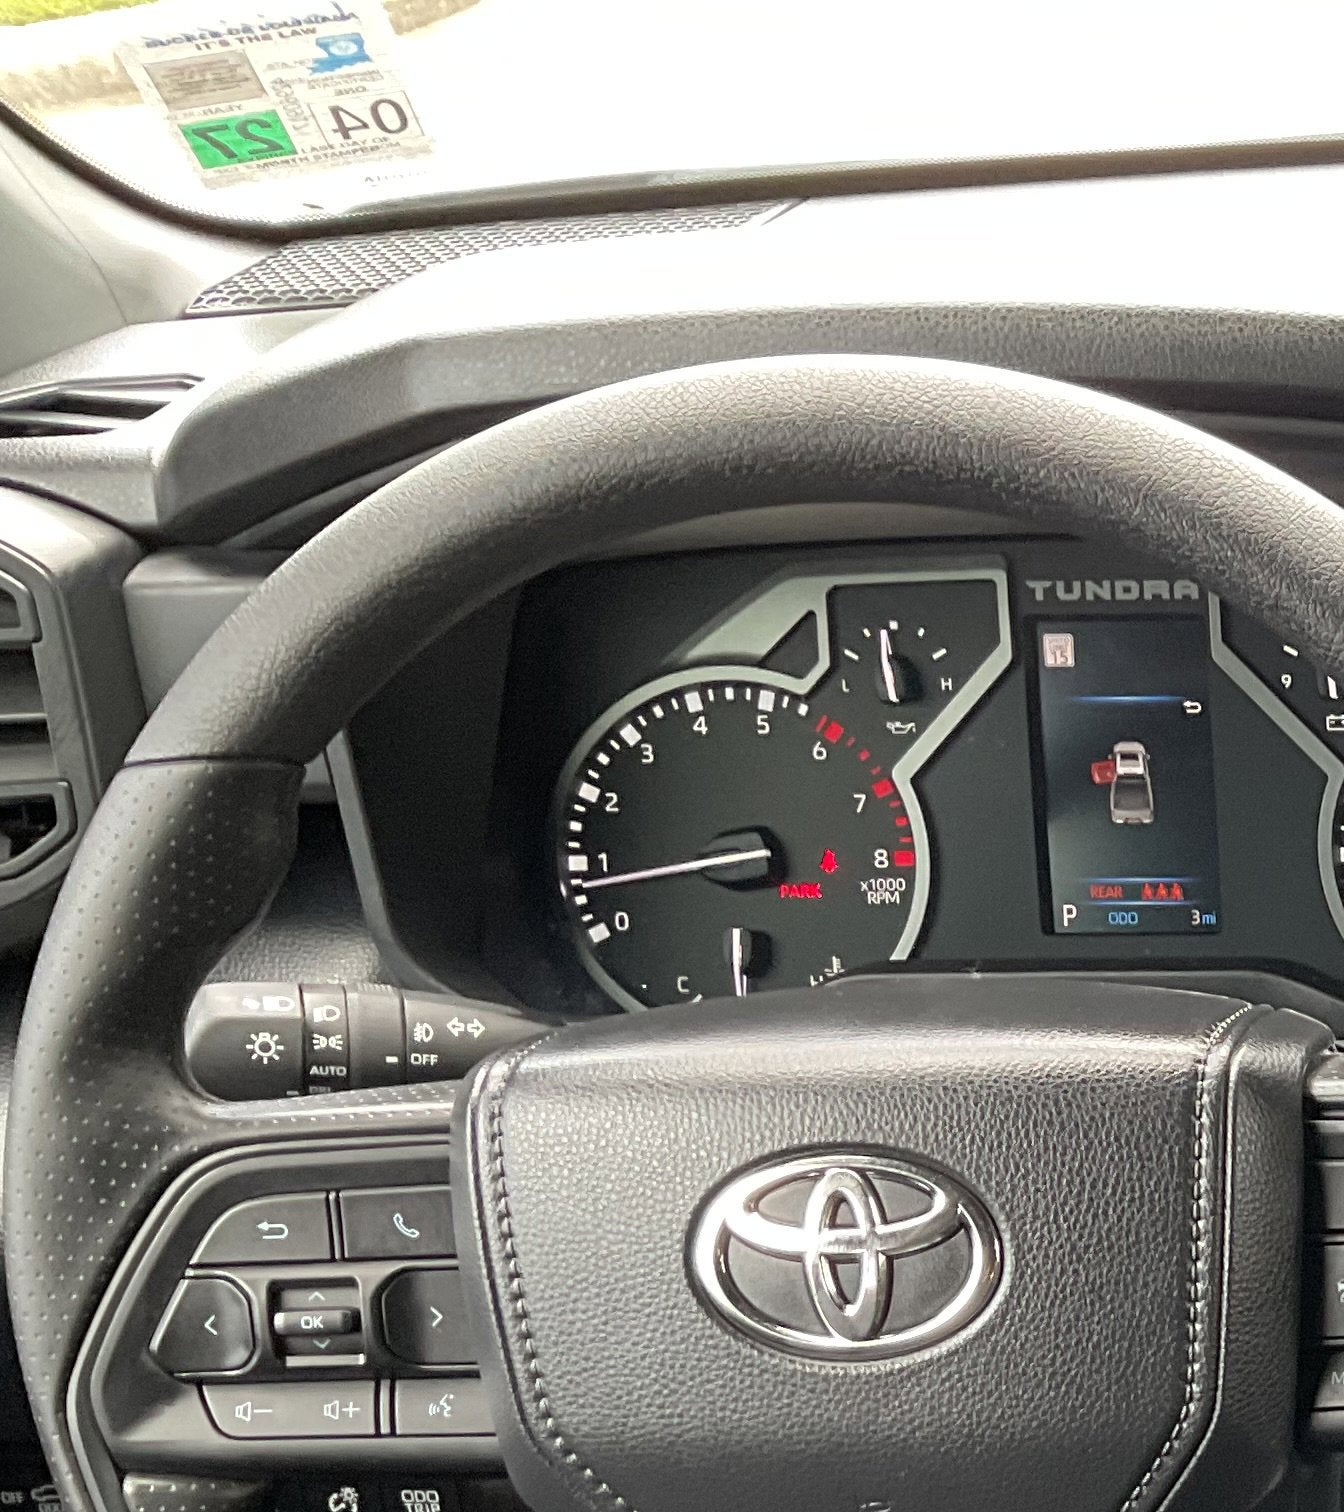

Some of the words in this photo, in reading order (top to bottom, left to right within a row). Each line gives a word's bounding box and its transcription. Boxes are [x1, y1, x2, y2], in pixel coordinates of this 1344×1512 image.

[278, 26, 318, 40] LAW
[1026, 579, 1200, 602] TUNDRA
[692, 714, 708, 735] 4
[756, 715, 771, 735] 5
[640, 744, 655, 765] 3
[812, 741, 828, 761] 6
[605, 793, 620, 814] 2
[853, 793, 868, 813] 7
[597, 853, 609, 872] 1
[873, 849, 890, 869] 8
[859, 877, 907, 893] x1000
[866, 890, 902, 906] RPM
[614, 911, 631, 932] 0
[1062, 904, 1078, 927] P
[1201, 910, 1217, 926] mi
[676, 975, 690, 994] C
[410, 1052, 439, 1066] OFF
[309, 1064, 348, 1078] AUTO
[300, 1314, 325, 1331] OK
